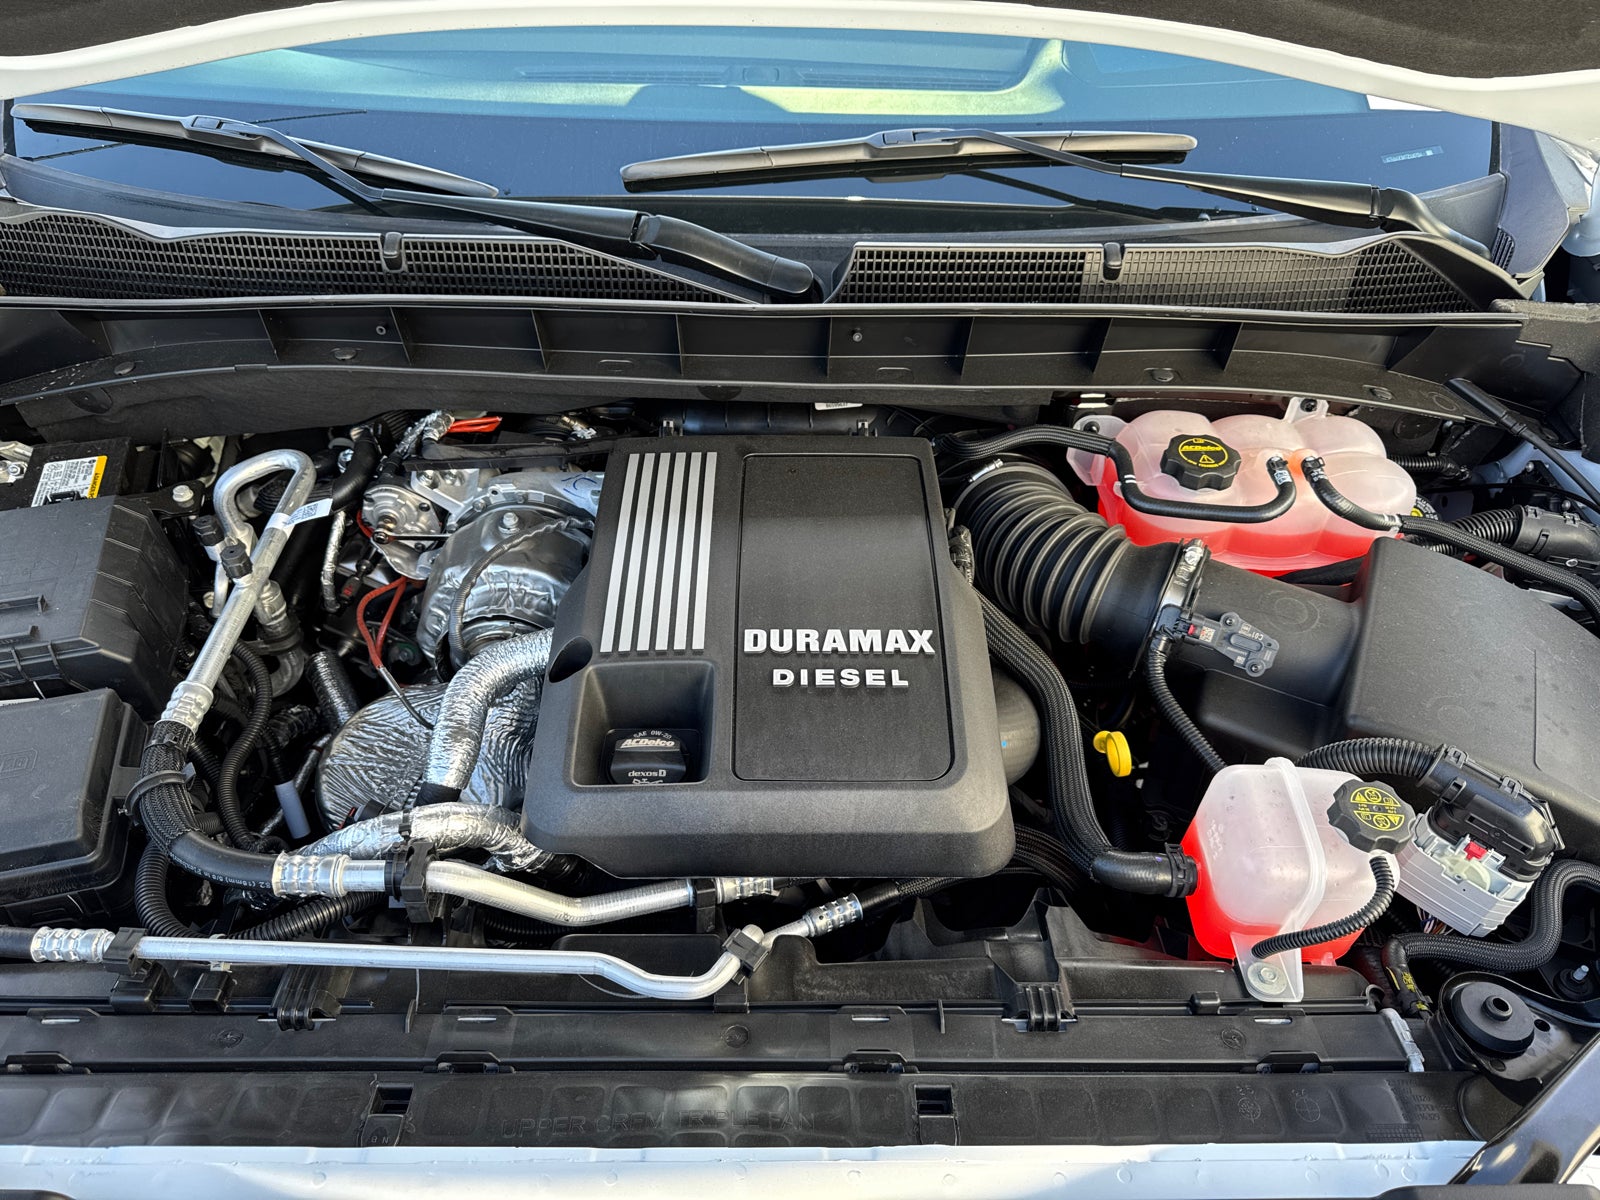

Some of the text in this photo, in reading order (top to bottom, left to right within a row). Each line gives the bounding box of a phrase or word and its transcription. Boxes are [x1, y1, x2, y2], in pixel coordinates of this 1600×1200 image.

[743, 628, 936, 654] DURAMAX
[772, 668, 909, 688] DIESEL
[620, 738, 676, 749] ACDelco
[633, 730, 648, 738] SAE
[501, 1115, 586, 1138] UPPER
[679, 1110, 759, 1128] TRIPLE
[768, 1111, 815, 1131] FAN
